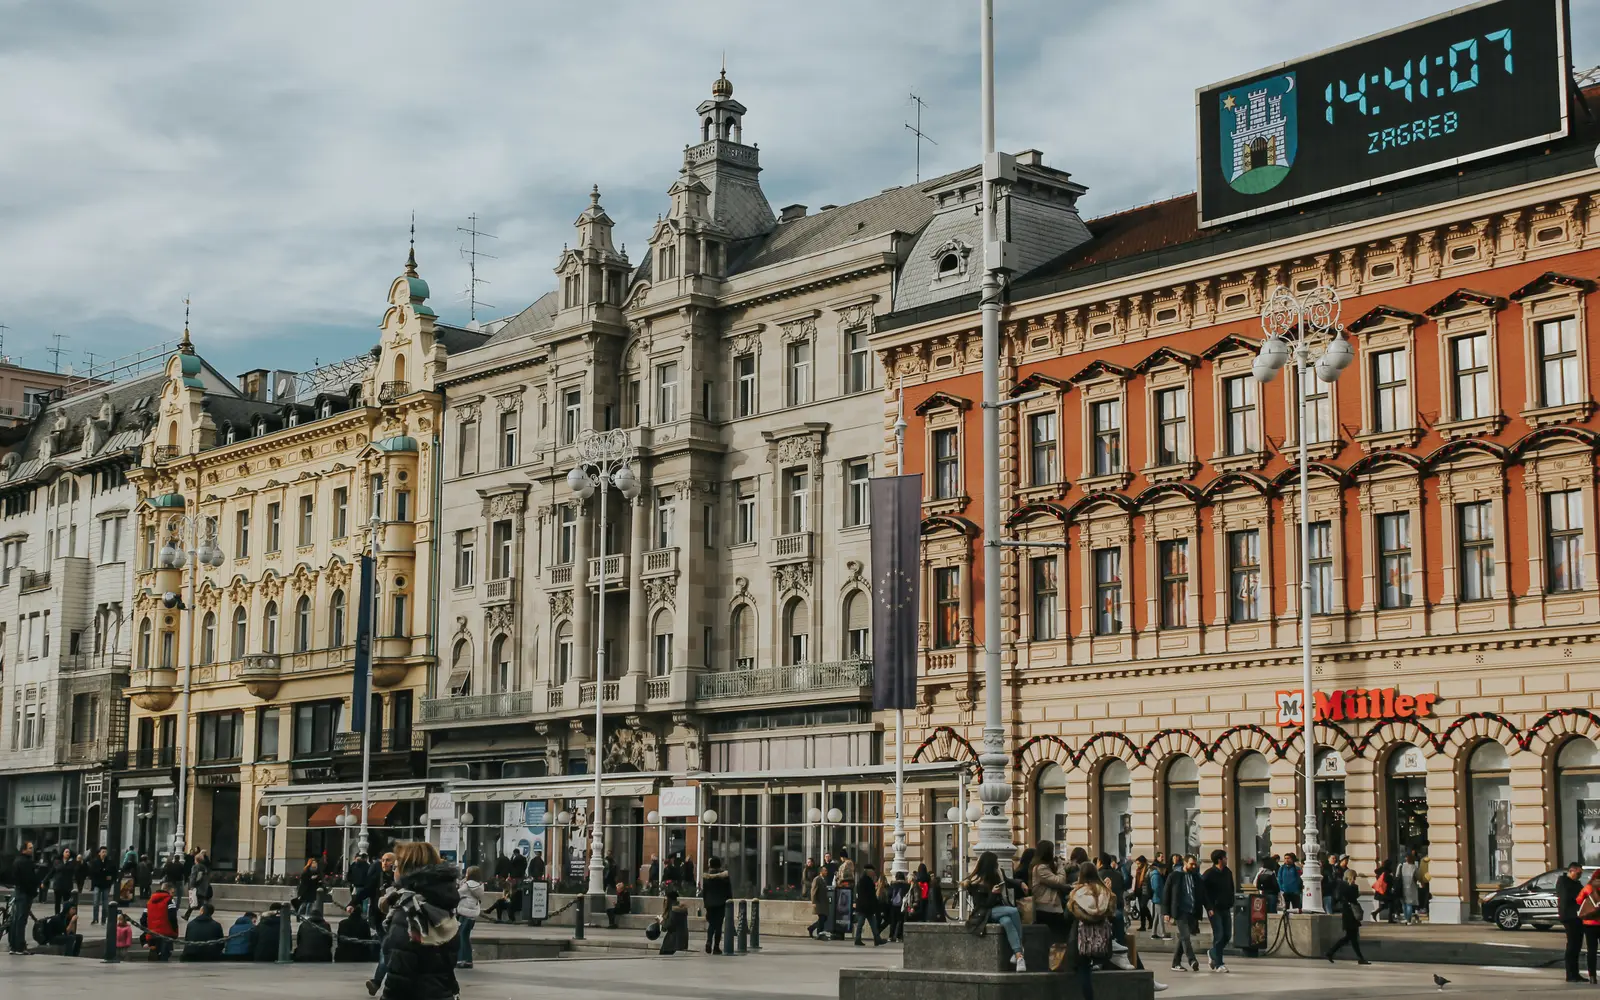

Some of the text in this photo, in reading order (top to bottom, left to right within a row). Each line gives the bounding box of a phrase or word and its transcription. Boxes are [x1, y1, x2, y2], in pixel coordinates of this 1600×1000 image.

[1325, 28, 1513, 125] 14:41:07
[1367, 111, 1458, 154] ZAGREB
[1282, 688, 1436, 721] M Müller
[20, 793, 56, 803] MALA KAVANA
[1523, 899, 1550, 908] KLEMM
